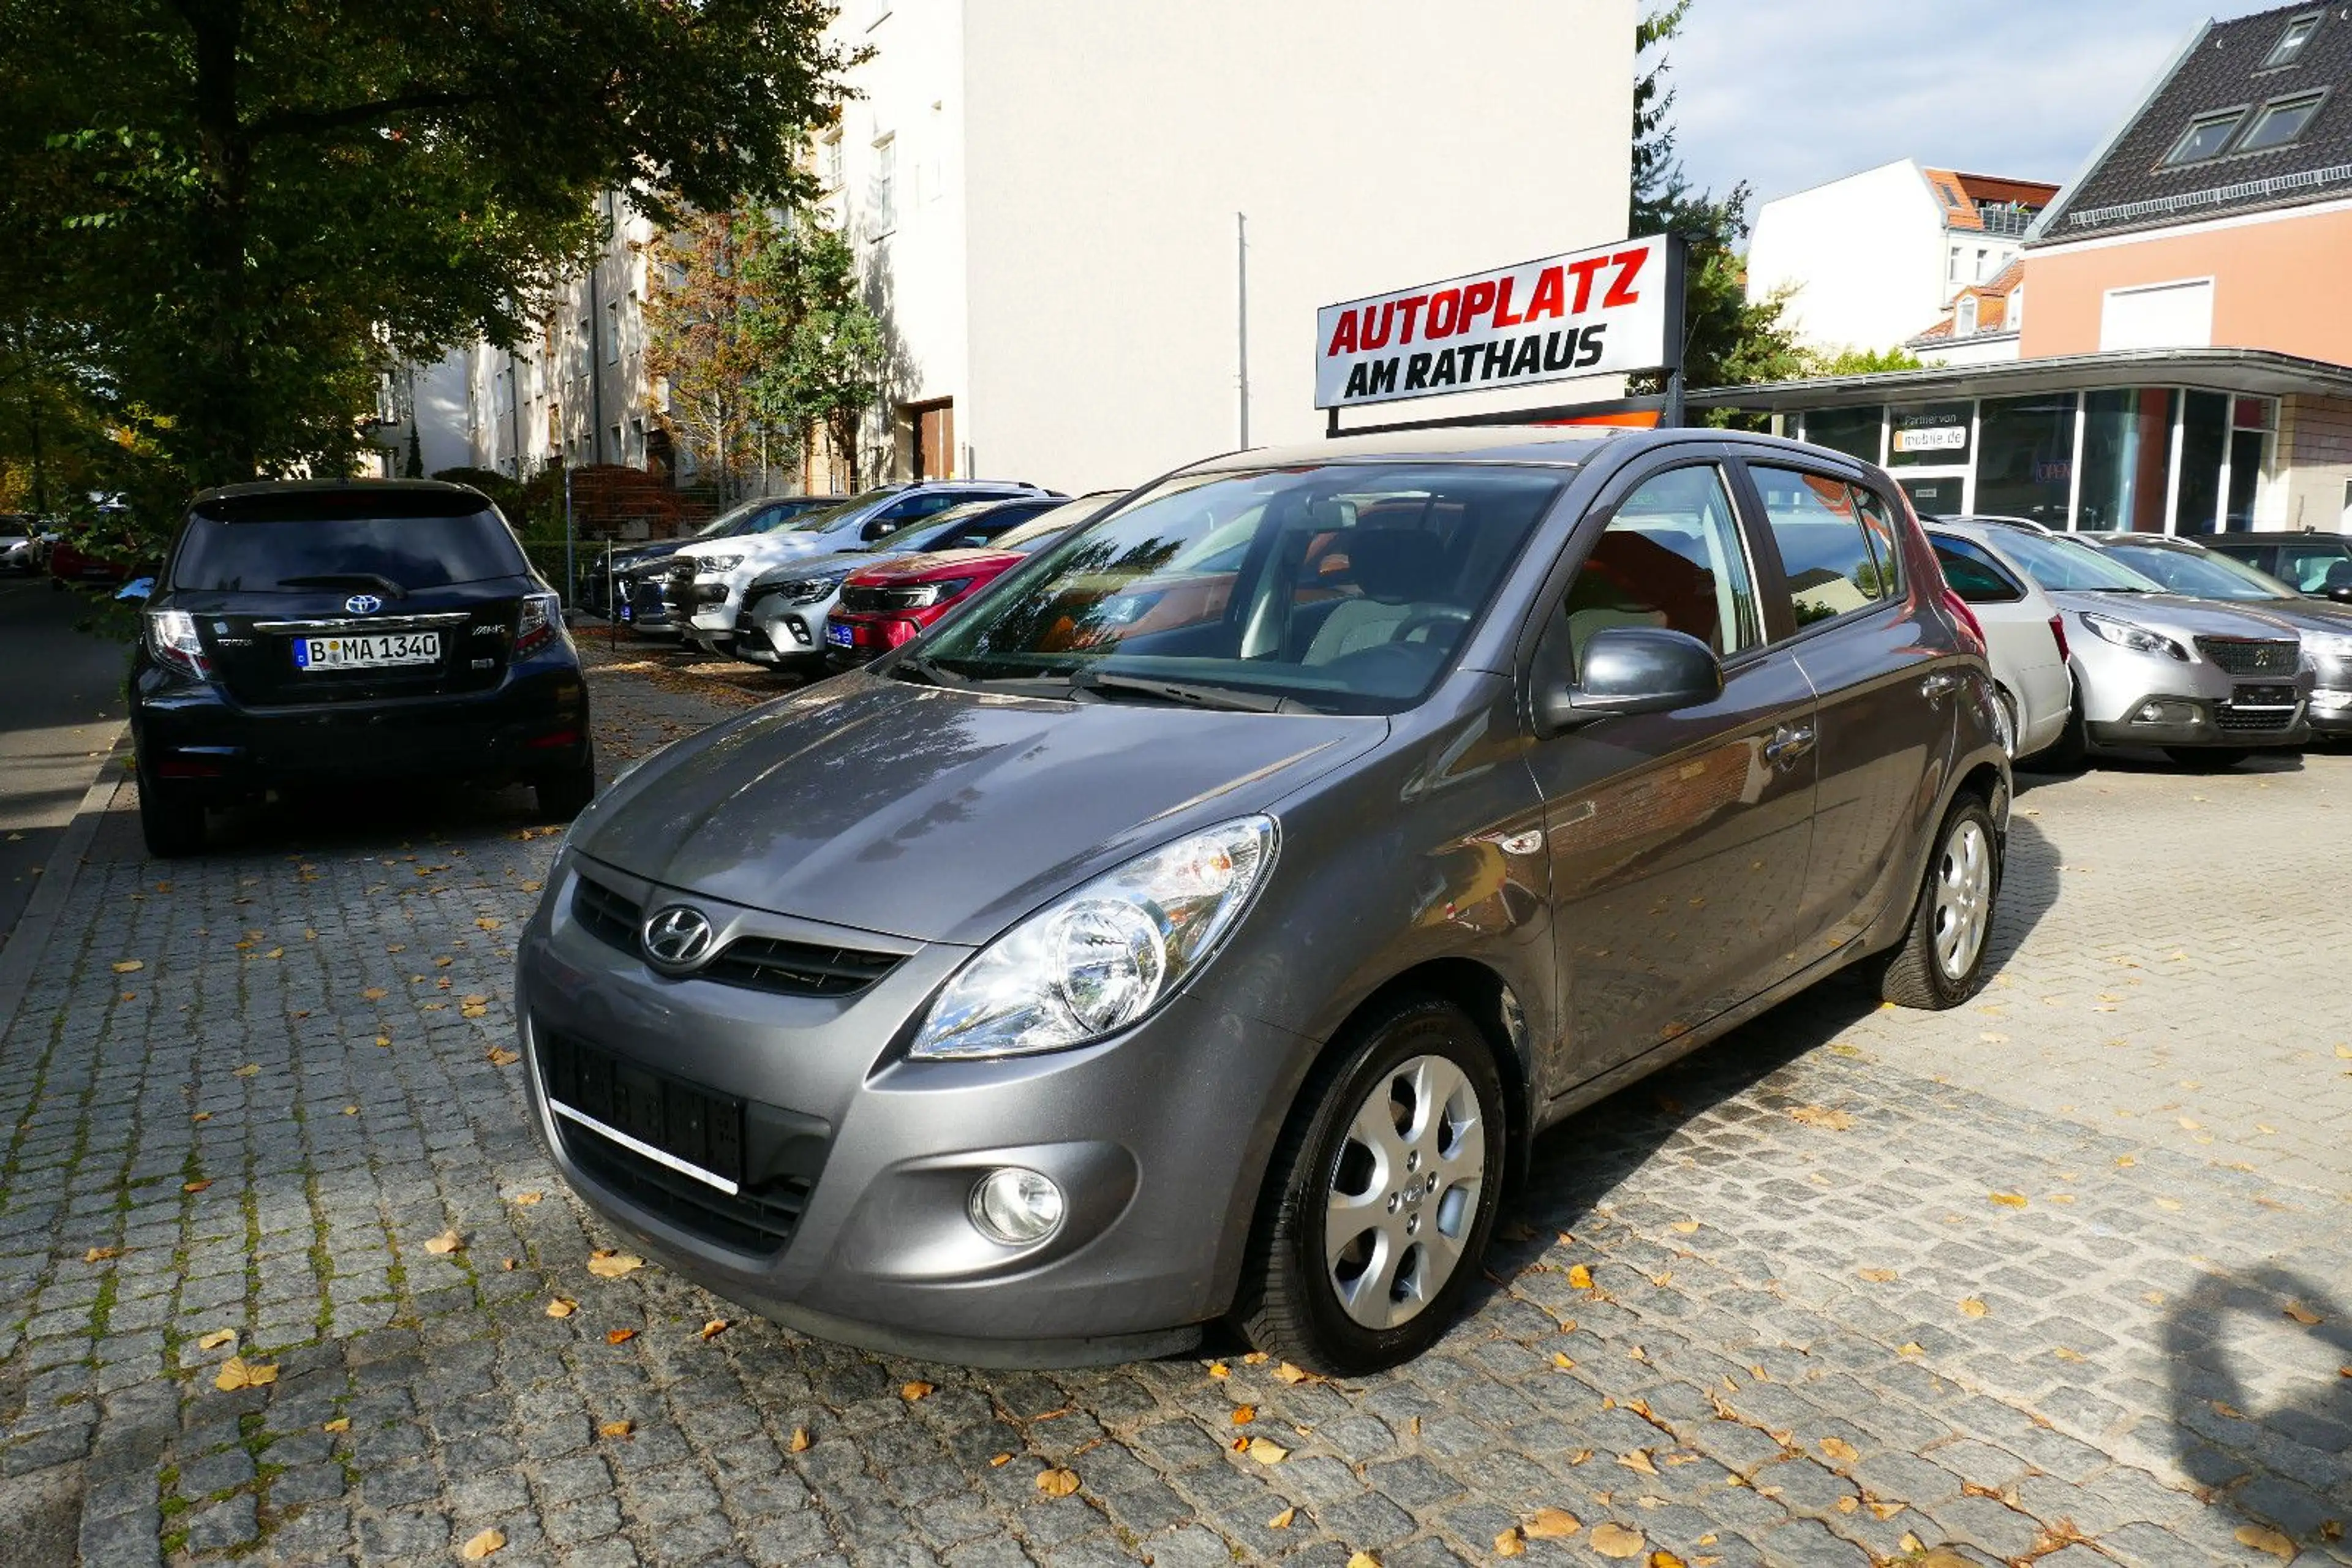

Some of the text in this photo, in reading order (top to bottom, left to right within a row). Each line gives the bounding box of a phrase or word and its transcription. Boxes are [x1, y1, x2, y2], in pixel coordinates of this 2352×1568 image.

[1327, 247, 1649, 356] AUTOPLATZ
[1344, 323, 1607, 399] AM RATHAUS
[1904, 414, 1956, 425] Partner von
[1905, 431, 1961, 446] mobile.de
[310, 641, 326, 662] B
[342, 639, 374, 660] MA
[379, 635, 437, 658] 1340
